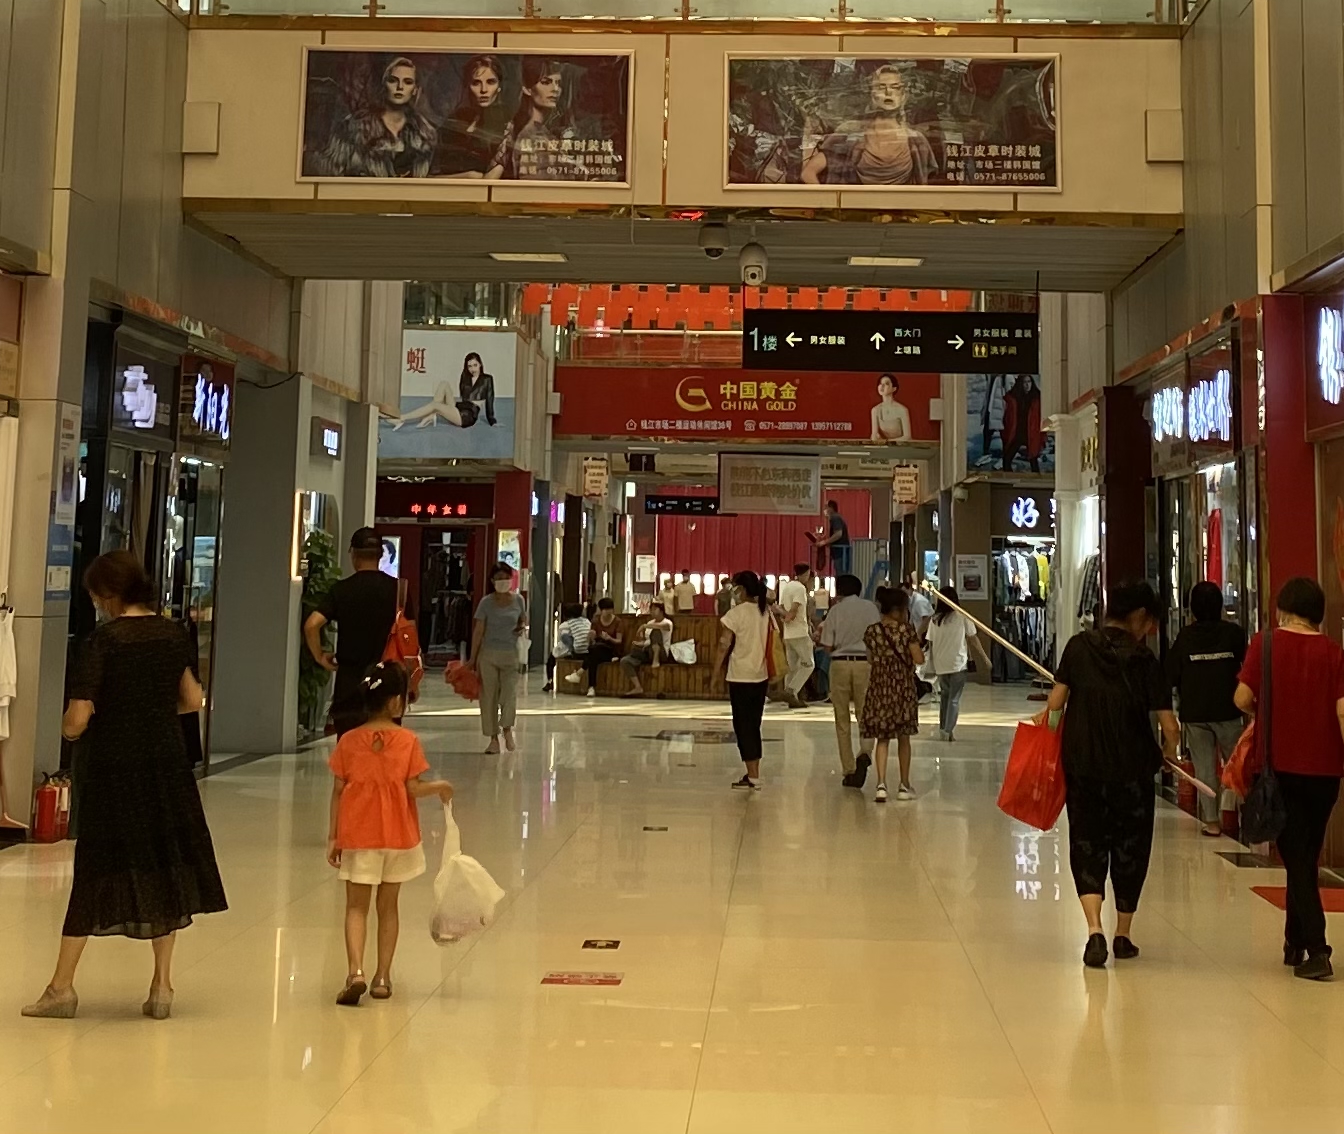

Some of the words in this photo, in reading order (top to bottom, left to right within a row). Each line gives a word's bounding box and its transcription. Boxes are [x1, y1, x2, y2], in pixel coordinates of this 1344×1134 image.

[749, 327, 778, 351] 1楼
[810, 335, 846, 346] 男女服装
[720, 380, 798, 400] 中国黄金
[721, 400, 759, 411] CHINA
[766, 400, 797, 411] GOLD
[1012, 497, 1056, 528] 好
